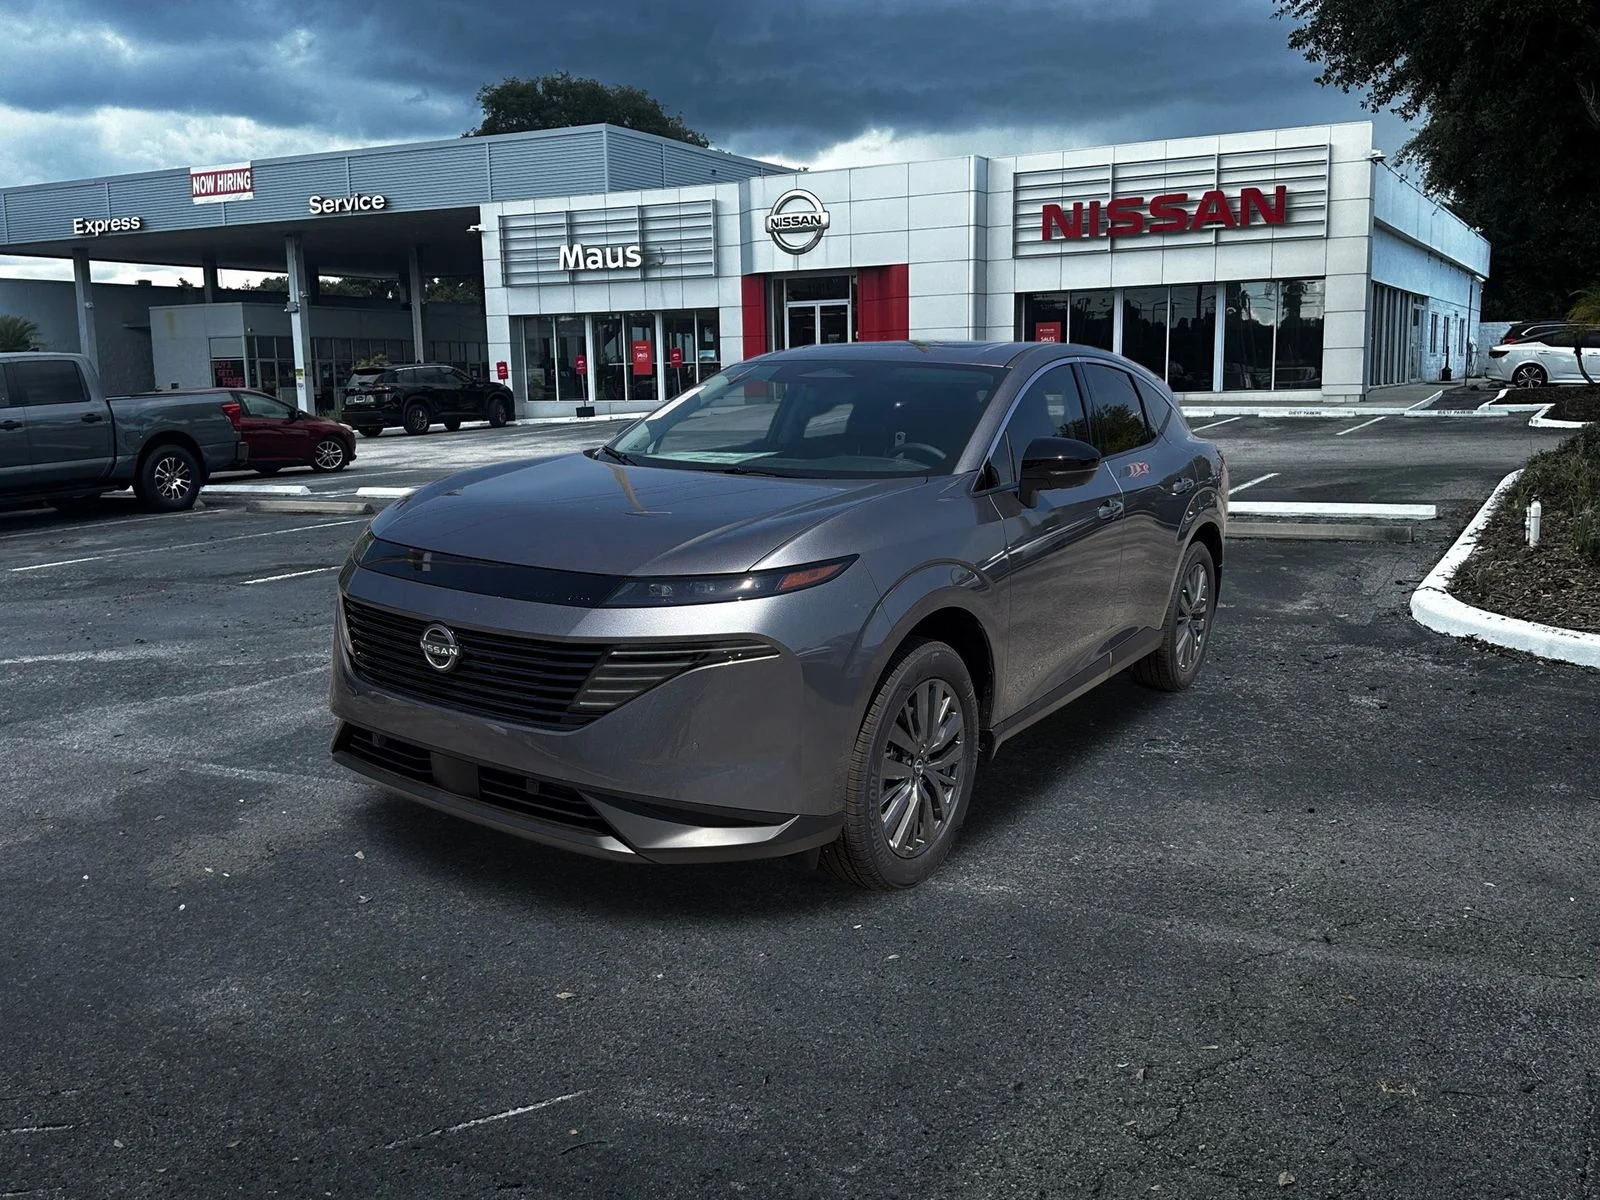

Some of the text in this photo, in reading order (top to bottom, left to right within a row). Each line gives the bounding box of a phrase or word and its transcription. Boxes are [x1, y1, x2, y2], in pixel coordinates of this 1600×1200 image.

[193, 171, 251, 195] NOW HIRING
[309, 193, 385, 214] Service
[1042, 185, 1287, 241] NISSAN
[72, 216, 141, 236] Express
[770, 214, 822, 228] NISSAN
[560, 244, 642, 270] Maus
[420, 641, 458, 656] NISSAN
